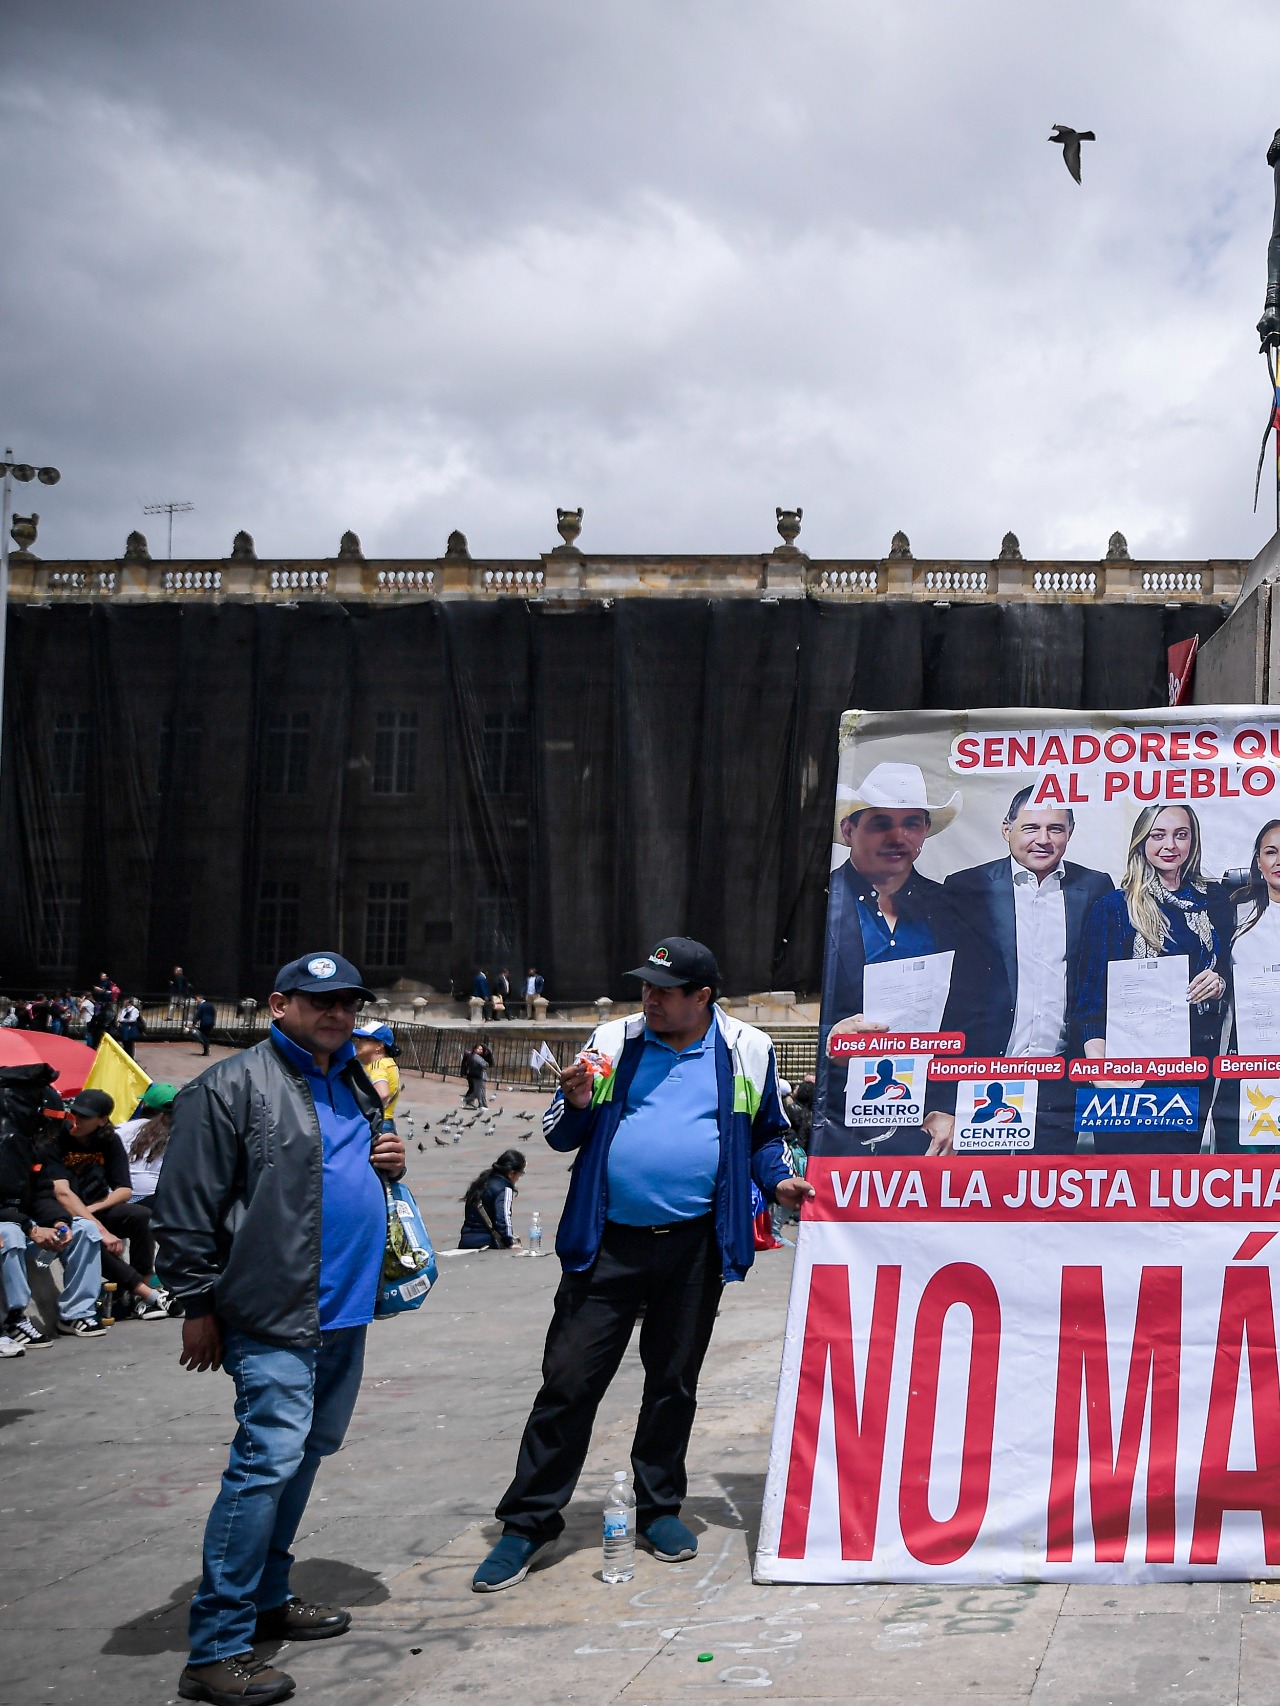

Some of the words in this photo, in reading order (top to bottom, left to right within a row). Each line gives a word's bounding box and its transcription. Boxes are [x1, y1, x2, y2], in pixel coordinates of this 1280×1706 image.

[956, 730, 1219, 768] SENADORES
[1034, 774, 1089, 803] AL
[1104, 766, 1276, 801] PUEBLO
[834, 1039, 866, 1051] José
[869, 1037, 906, 1050] Alirio
[910, 1037, 961, 1049] Barrera
[930, 1062, 987, 1074] Honorio
[990, 1061, 1061, 1075] Henríquez
[1071, 1062, 1099, 1075] Ana
[1104, 1062, 1143, 1074] Paola
[1146, 1062, 1207, 1076] Agudelo
[852, 1104, 920, 1115] CENTRO
[1082, 1093, 1193, 1117] MIRA
[852, 1116, 919, 1124] DEMOCRÁTICO
[1137, 1117, 1194, 1125] POLÍTICO
[960, 1128, 1030, 1139] CENTRO
[960, 1139, 1030, 1148] DEMOCRÁTICO
[831, 1170, 928, 1208] VIVA
[940, 1171, 991, 1208] LA
[1003, 1169, 1137, 1208] JUSTA
[778, 1262, 1002, 1566] NO
